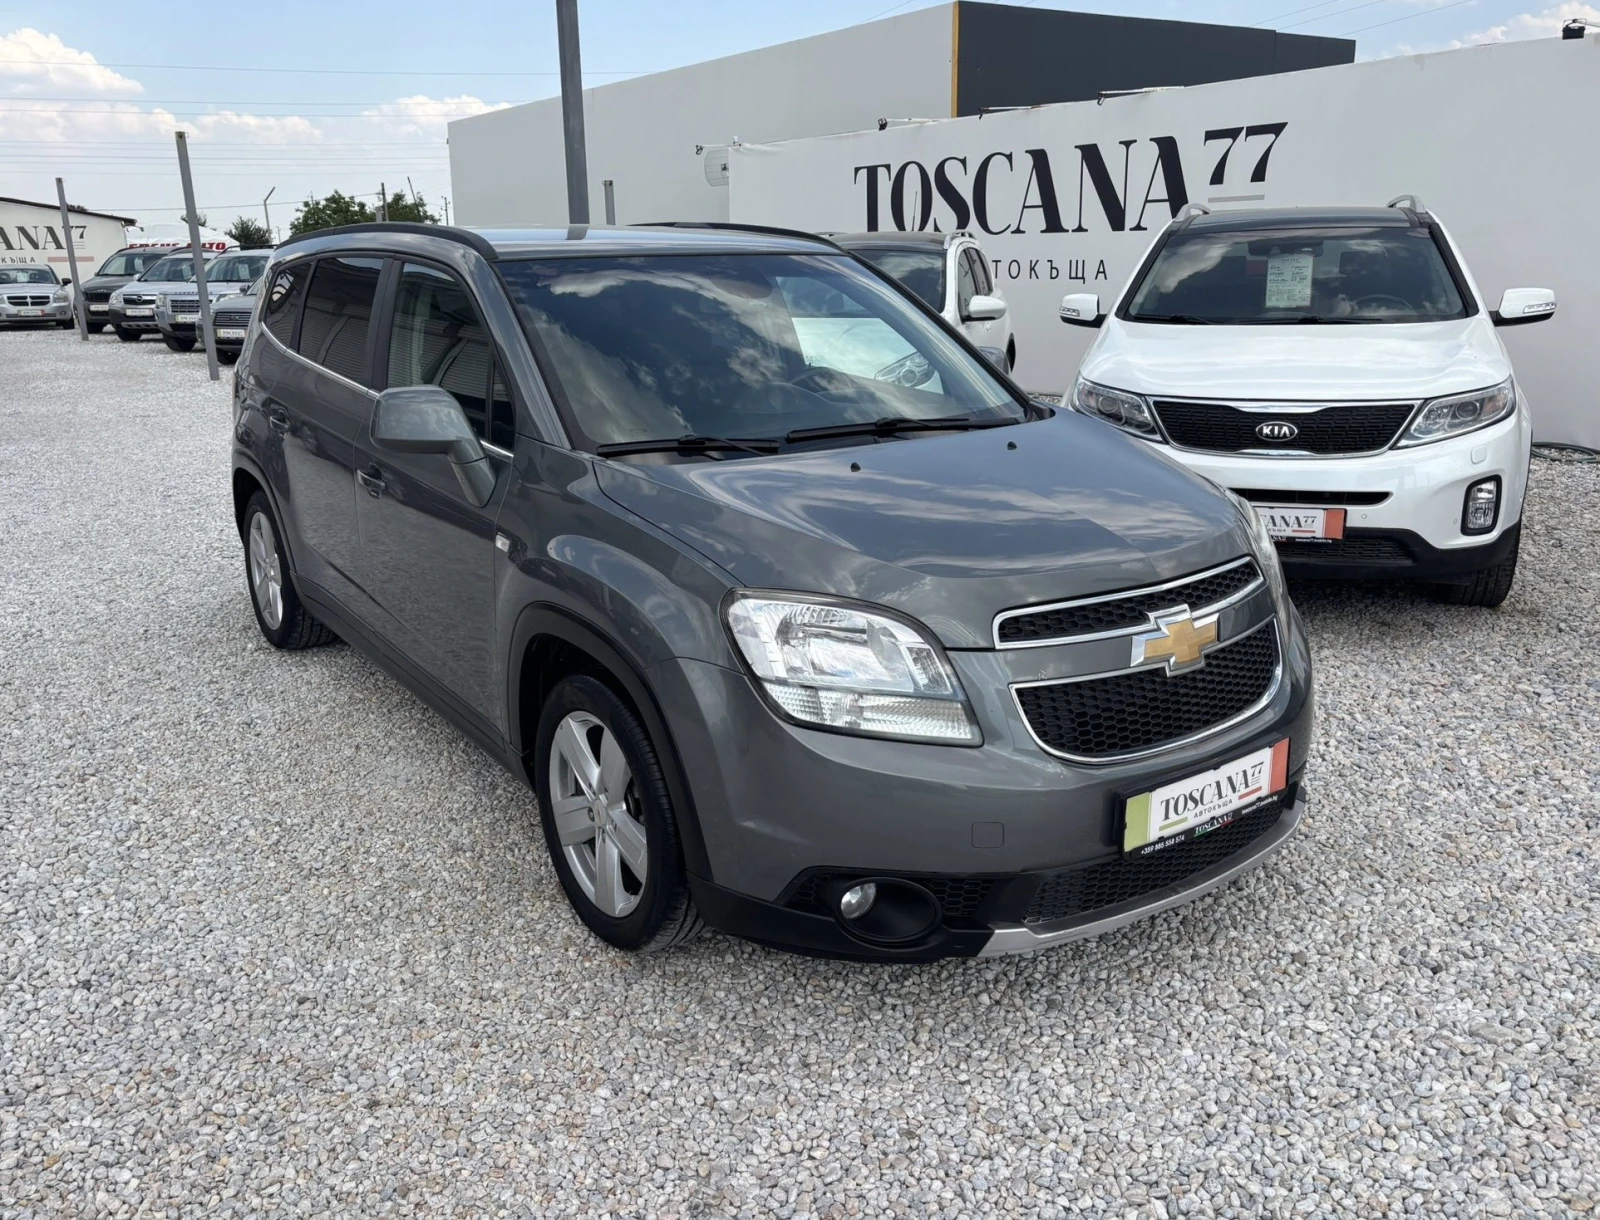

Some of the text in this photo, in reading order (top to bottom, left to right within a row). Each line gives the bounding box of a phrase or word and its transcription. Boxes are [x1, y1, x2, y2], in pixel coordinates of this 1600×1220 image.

[854, 122, 1288, 235] TOSCANA 77
[991, 259, 1107, 284] ТОКЪЩА
[1262, 425, 1291, 437] KIA
[1161, 761, 1264, 821] TOSCANA 77
[1193, 799, 1233, 818] АВТОКЪЩА
[1140, 845, 1154, 855] +359
